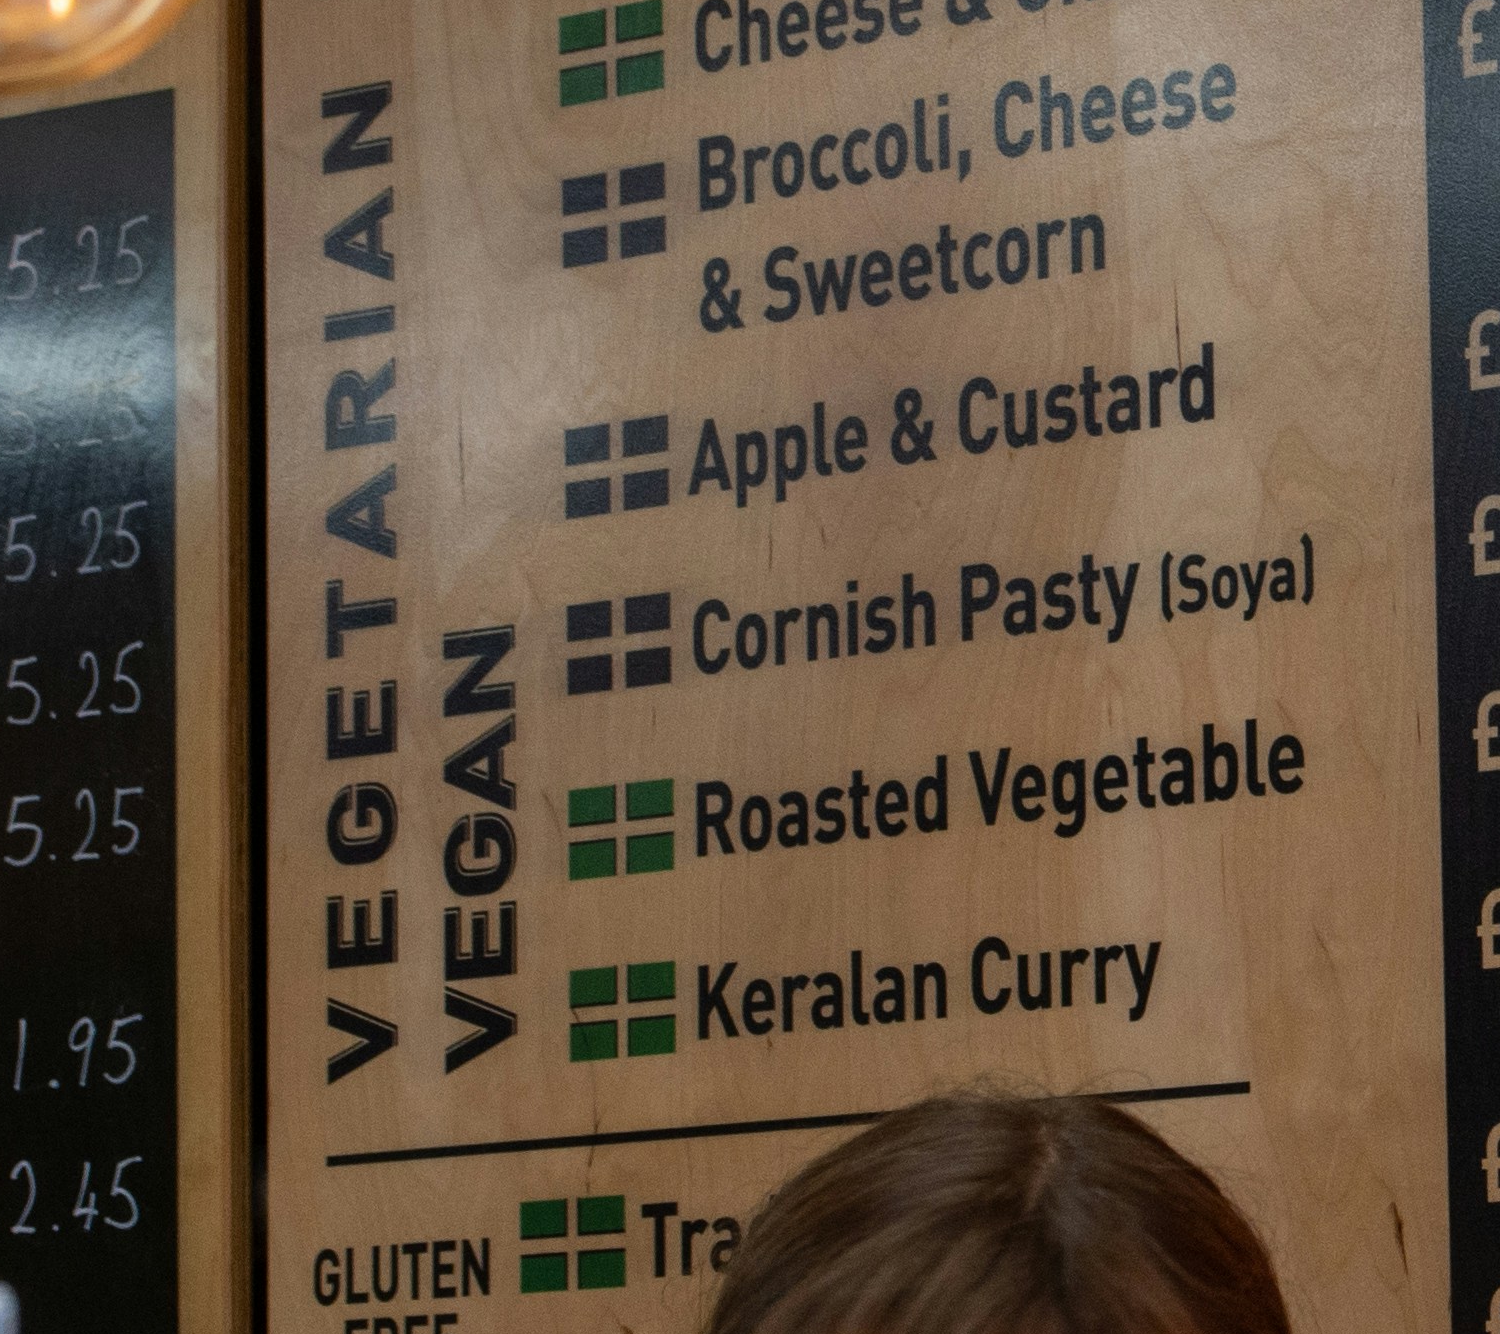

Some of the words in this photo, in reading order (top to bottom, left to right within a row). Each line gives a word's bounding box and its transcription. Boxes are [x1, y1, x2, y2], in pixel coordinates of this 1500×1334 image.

[698, 94, 971, 213] Broccoli,
[992, 64, 1236, 160] Cheese
[699, 257, 744, 334] &
[763, 214, 1106, 323] Sweetcorn
[688, 401, 869, 509] Apple
[890, 387, 937, 465] &
[957, 342, 1215, 456] Custard
[322, 79, 399, 1086] VEGETARIAN
[692, 572, 937, 675] Cornish
[960, 554, 1139, 643] Pasty
[1160, 533, 1315, 622] (Soya)
[443, 622, 518, 1075] VEGAN
[696, 754, 949, 857] Roasted
[968, 718, 1305, 839] Vegetable
[697, 950, 948, 1040] Keralan
[970, 936, 1161, 1022] Curry
[313, 1237, 491, 1307] GLUTEN
